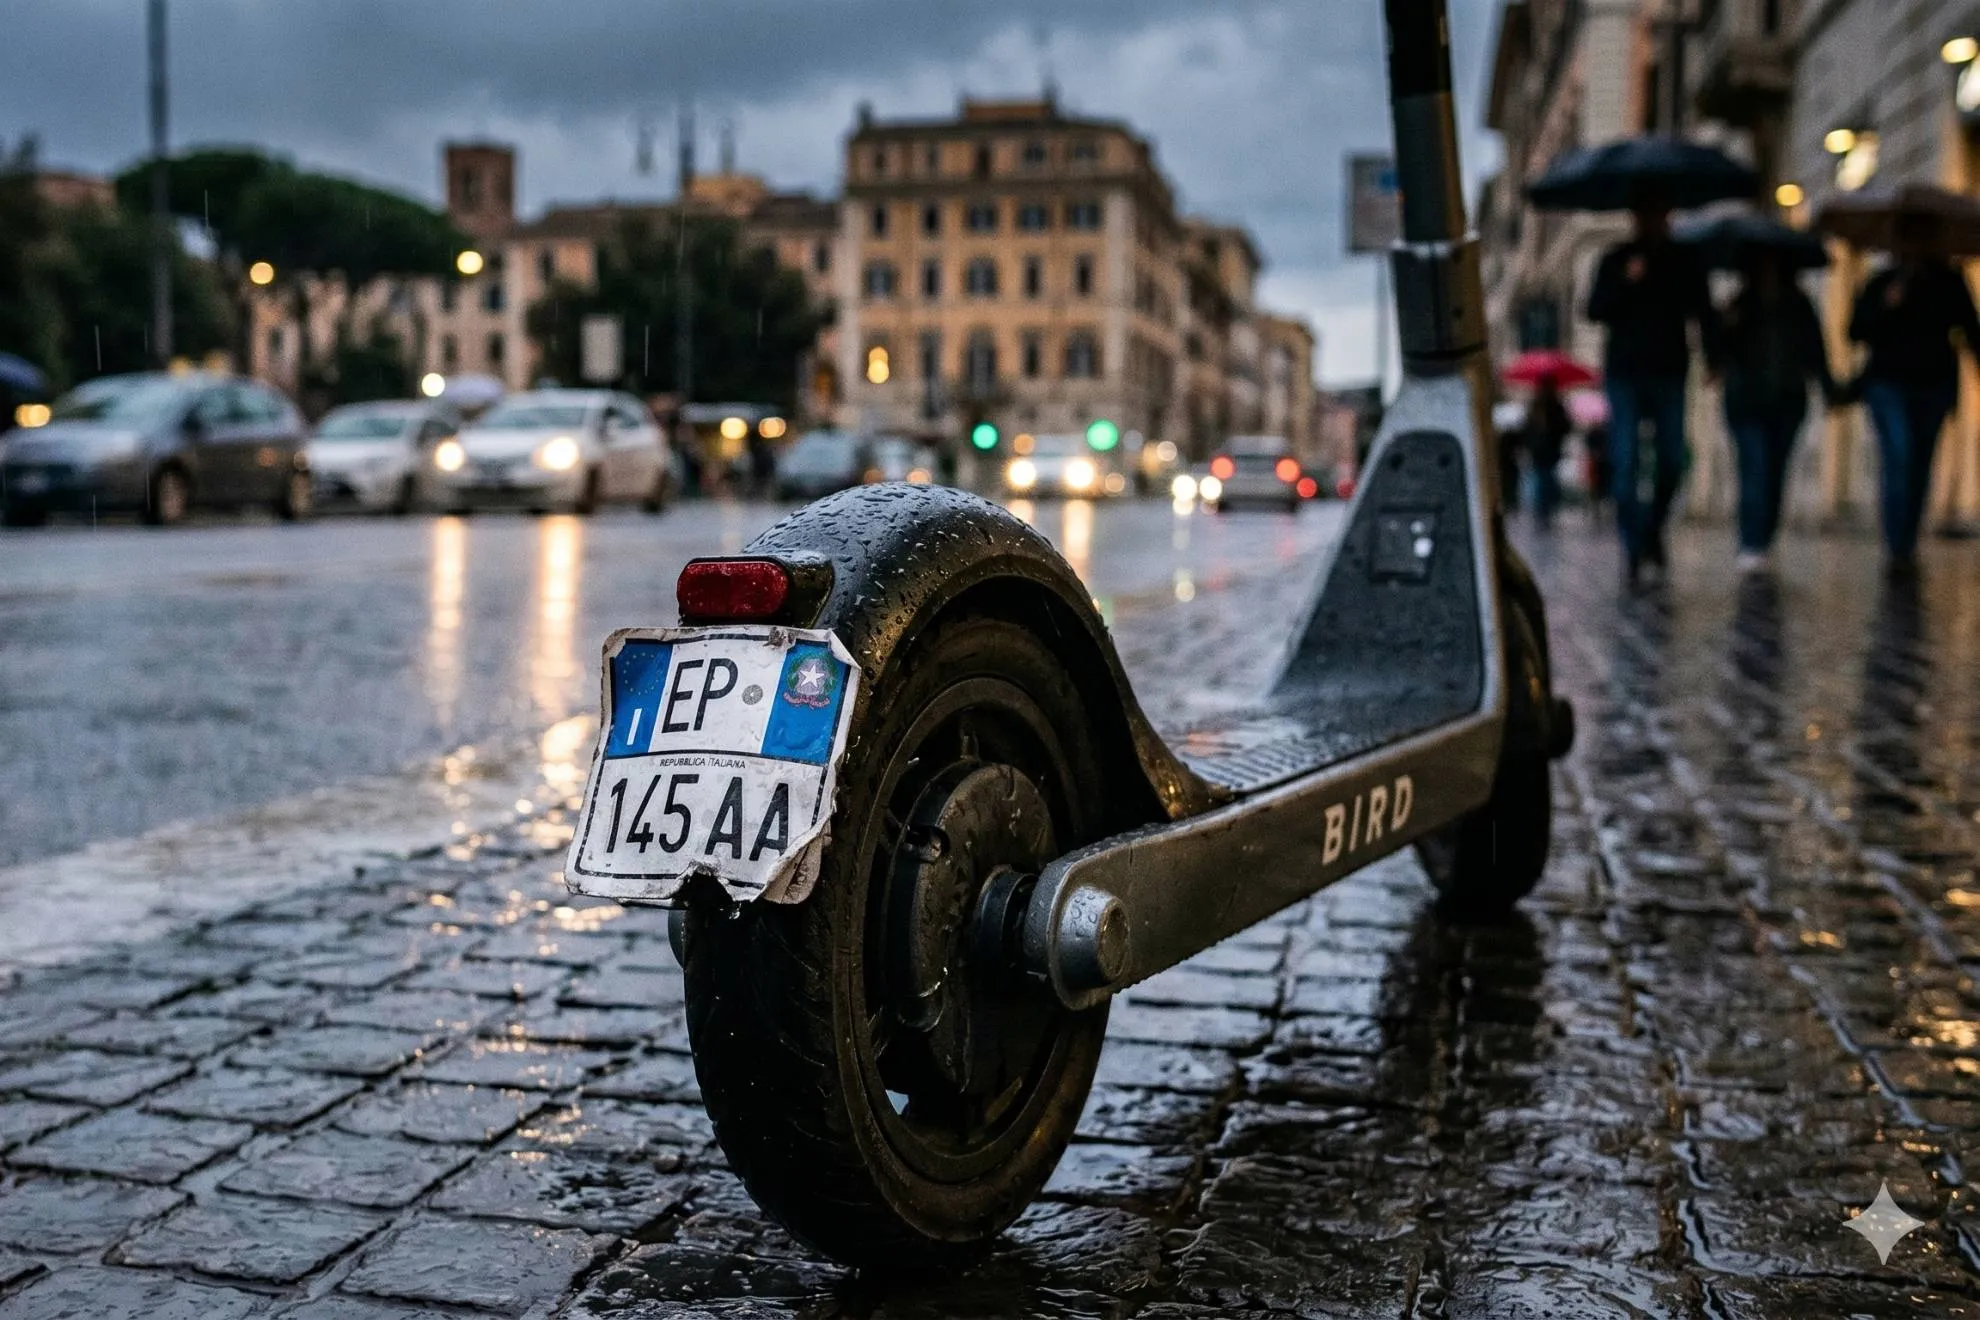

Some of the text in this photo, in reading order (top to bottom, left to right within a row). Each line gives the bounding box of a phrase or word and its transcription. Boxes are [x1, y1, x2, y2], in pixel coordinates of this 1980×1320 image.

[626, 708, 642, 746] I
[661, 658, 739, 734] EP
[660, 757, 706, 768] REPUBBLICA
[606, 774, 789, 862] 145 AA
[1322, 775, 1413, 866] BIRD
